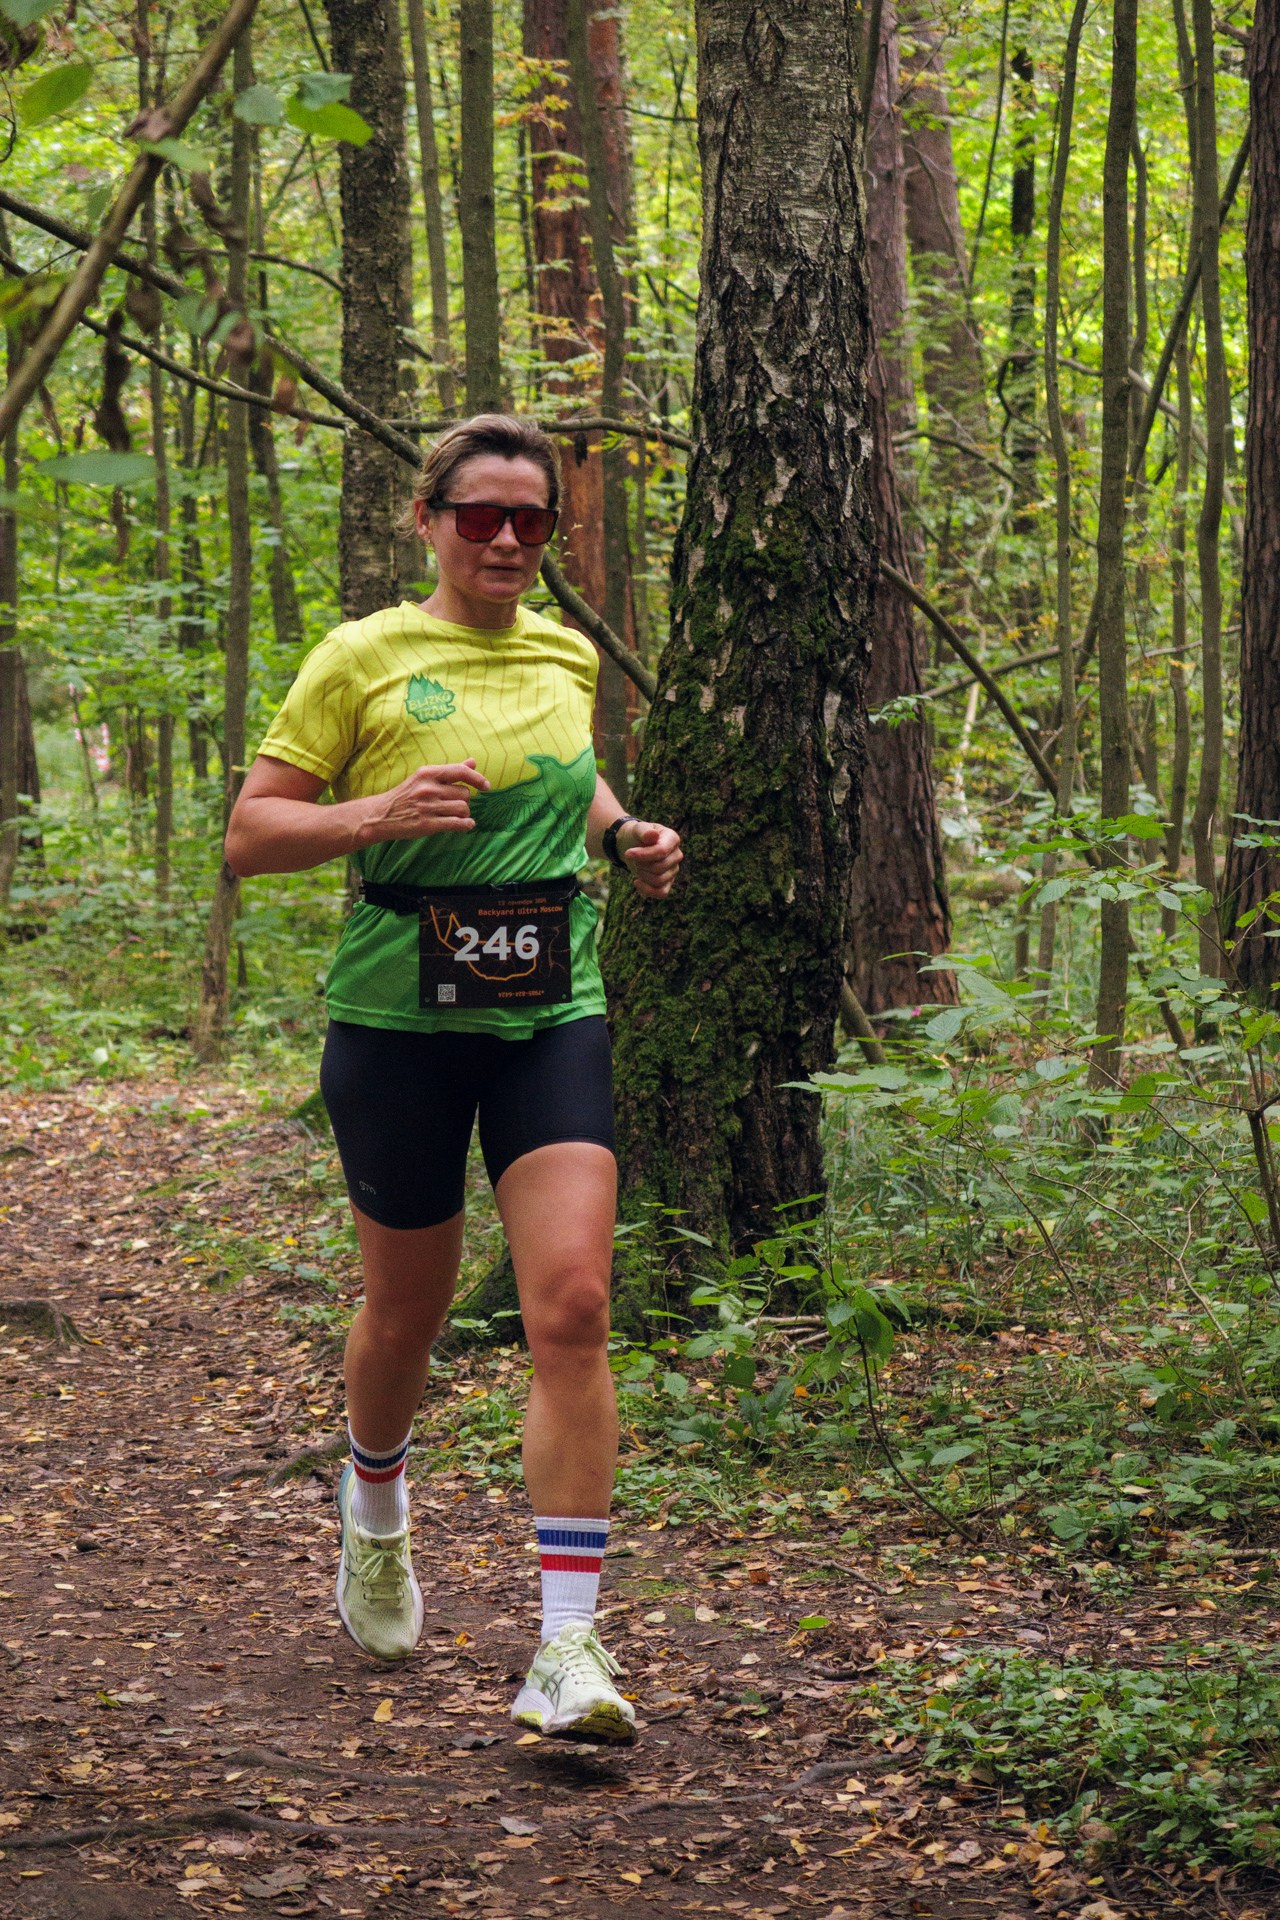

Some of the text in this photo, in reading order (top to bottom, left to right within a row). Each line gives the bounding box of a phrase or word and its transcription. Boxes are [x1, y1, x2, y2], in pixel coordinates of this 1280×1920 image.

[418, 705, 453, 720] TRAIL
[478, 908, 514, 917] Backyard
[517, 907, 538, 915] Ultra
[455, 925, 539, 961] 246
